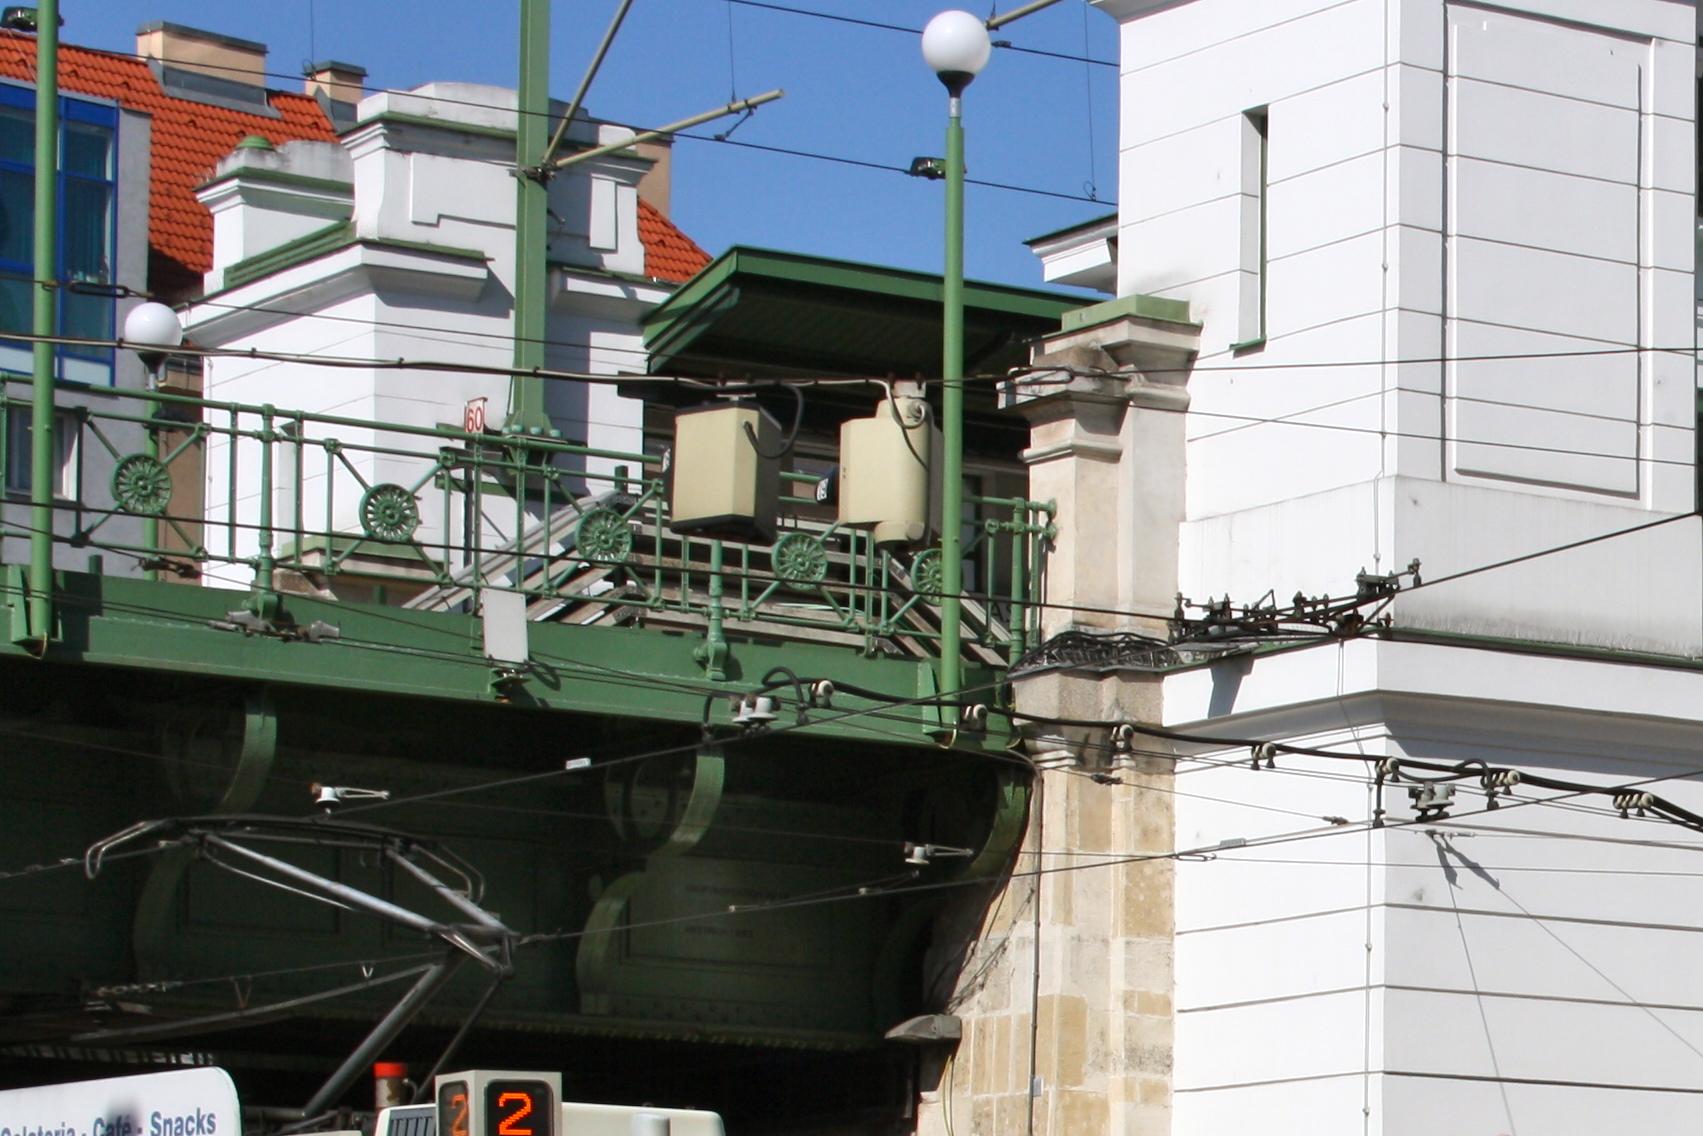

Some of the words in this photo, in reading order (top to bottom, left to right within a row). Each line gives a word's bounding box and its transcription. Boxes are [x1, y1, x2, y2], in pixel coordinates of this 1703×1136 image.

[467, 406, 483, 433] 60
[450, 1094, 468, 1136] 2
[499, 1092, 532, 1136] 2
